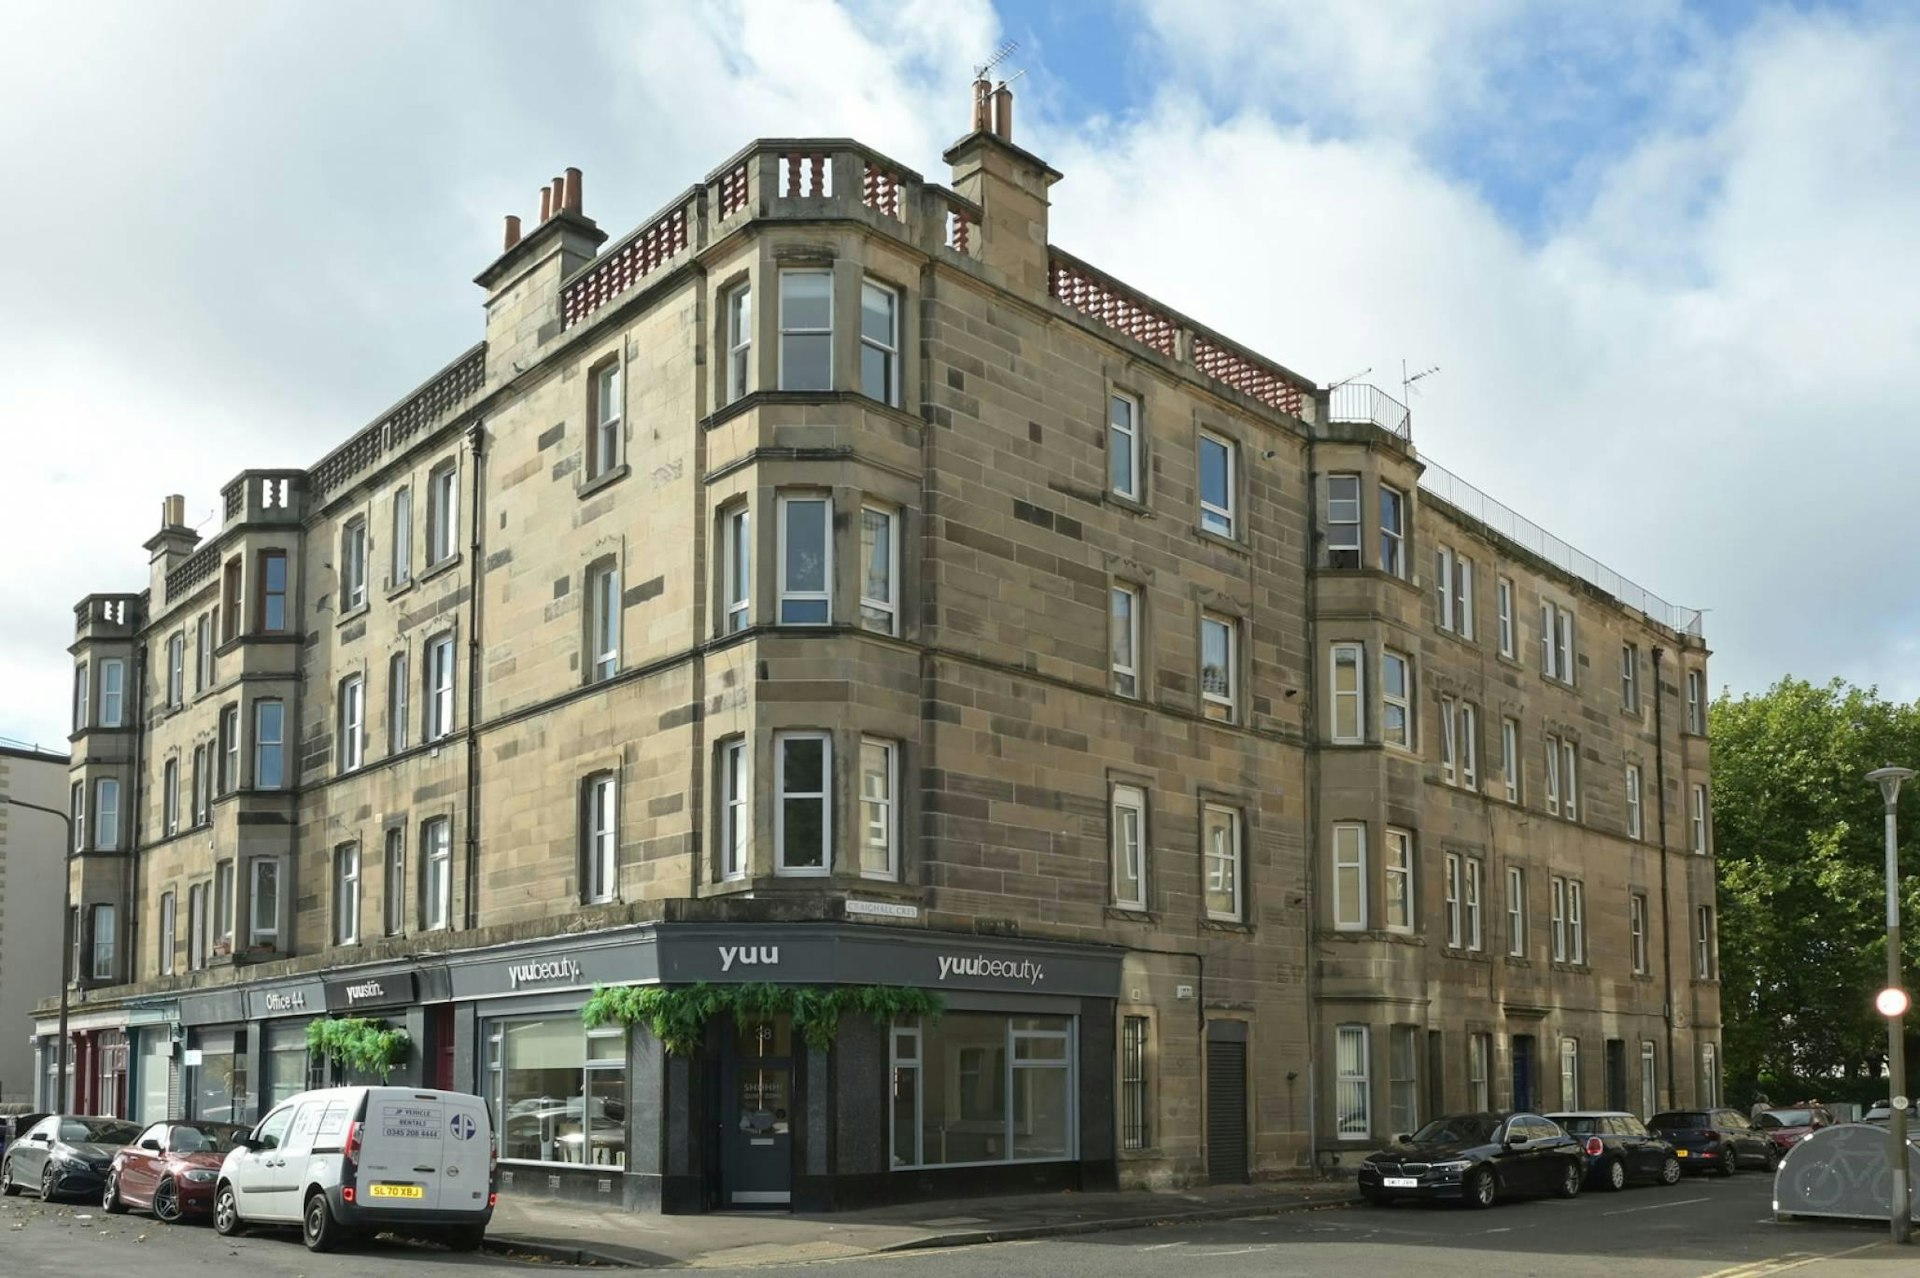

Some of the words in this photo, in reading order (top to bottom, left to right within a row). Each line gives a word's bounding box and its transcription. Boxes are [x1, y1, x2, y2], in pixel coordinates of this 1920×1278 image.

[718, 946, 779, 972] yuu
[938, 954, 1044, 986] yuubeauty.
[508, 956, 580, 989] yuubeauty.
[266, 993, 291, 1010] Office
[292, 990, 304, 1007] 44
[386, 1128, 404, 1137] 0345
[406, 1129, 419, 1137] 208
[421, 1130, 438, 1138] 4444
[399, 1119, 426, 1127] RENTALS
